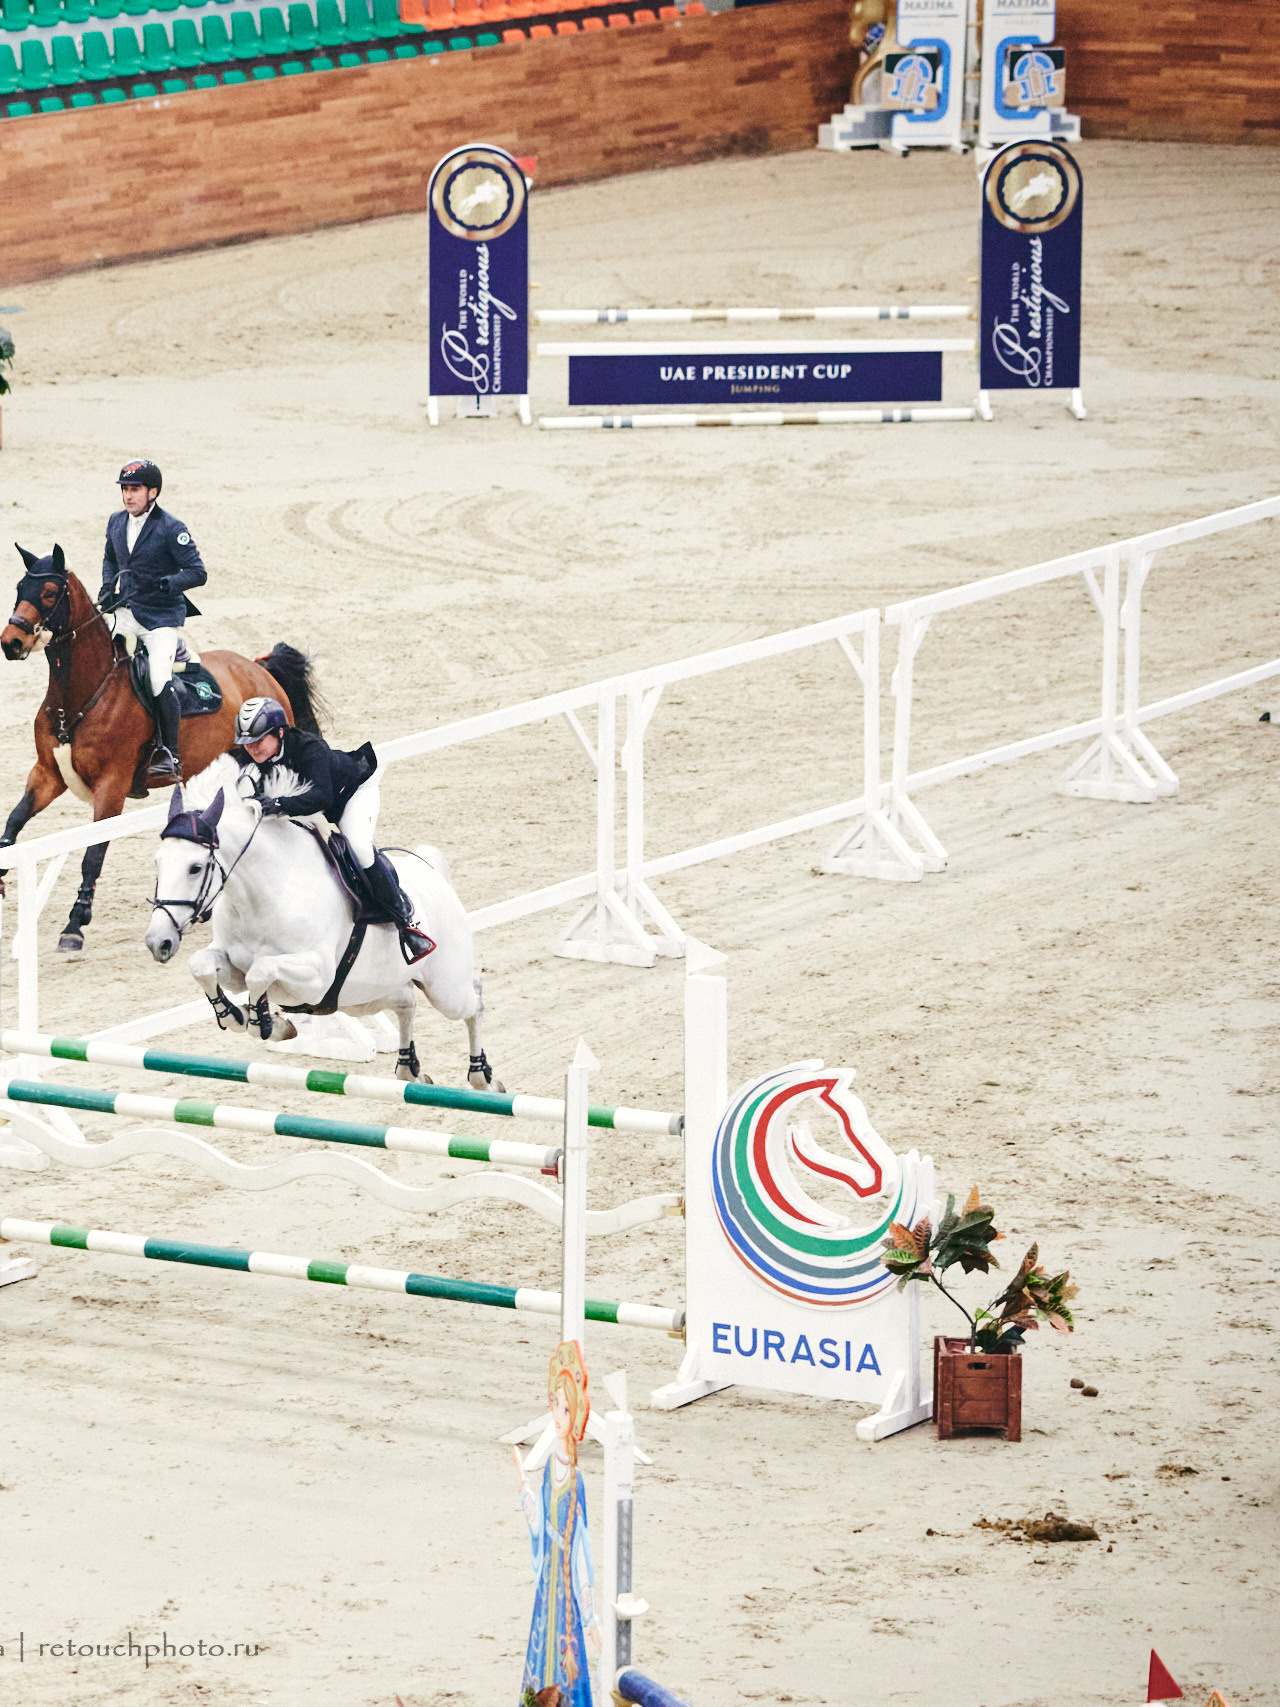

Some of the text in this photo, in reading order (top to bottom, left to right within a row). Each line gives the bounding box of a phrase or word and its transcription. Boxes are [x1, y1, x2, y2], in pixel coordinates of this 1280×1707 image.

[441, 243, 518, 394] Prestigious
[992, 235, 1070, 388] Prestigious
[660, 364, 852, 381] UAE PRESIDENT CUP
[712, 1322, 882, 1376] EURASIA
